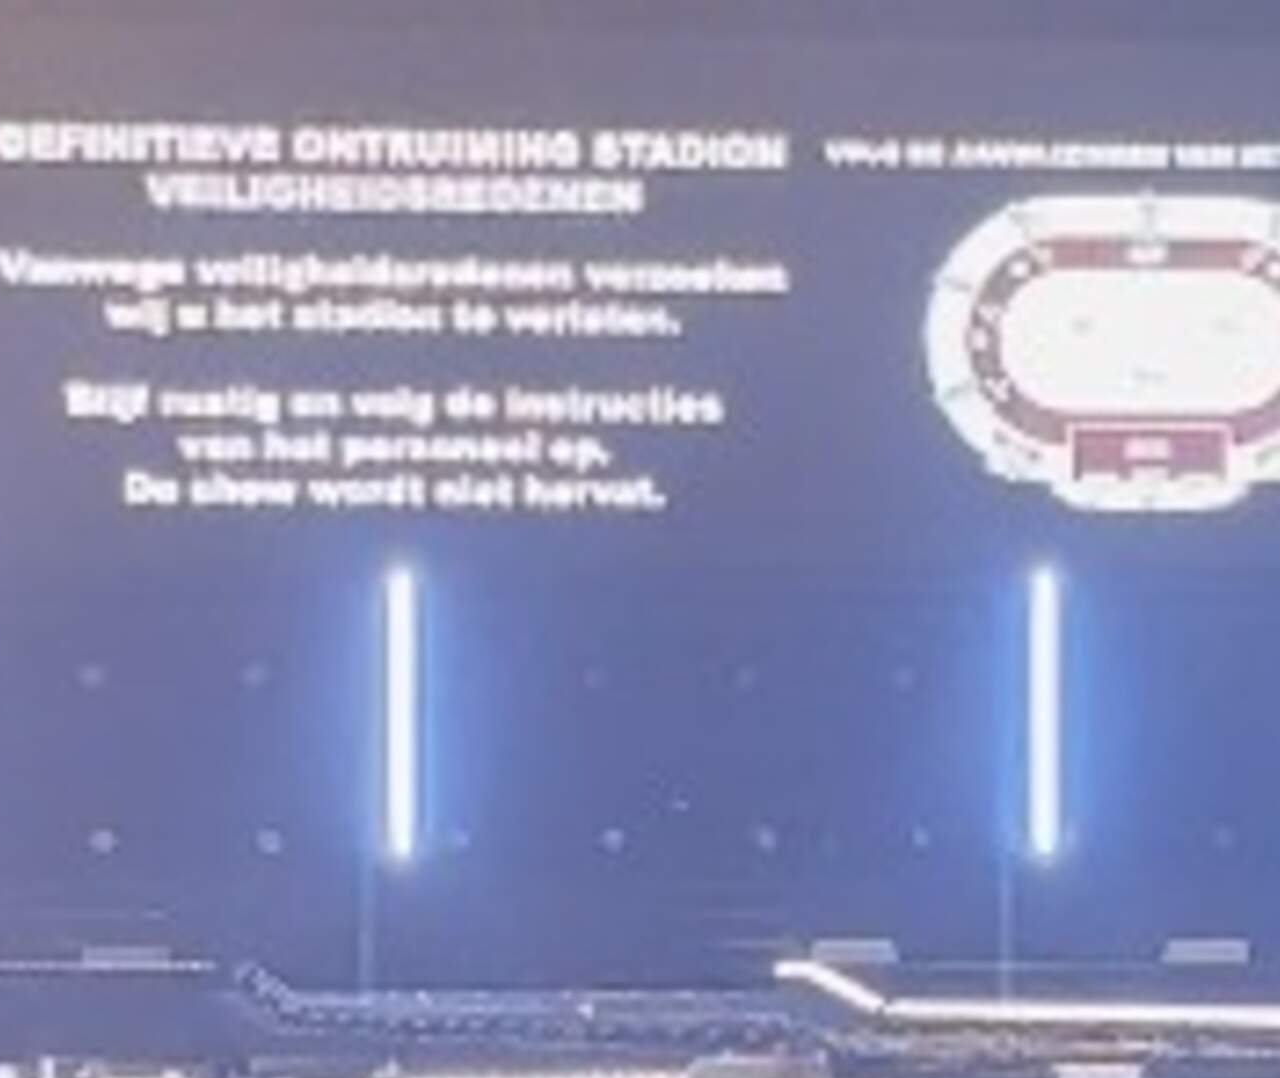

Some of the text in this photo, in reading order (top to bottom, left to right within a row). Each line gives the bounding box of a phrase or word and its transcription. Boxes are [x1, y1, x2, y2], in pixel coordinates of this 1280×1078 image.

[292, 126, 581, 168] ONTRUIMING
[591, 131, 788, 170] STADION
[505, 387, 724, 424] instructies
